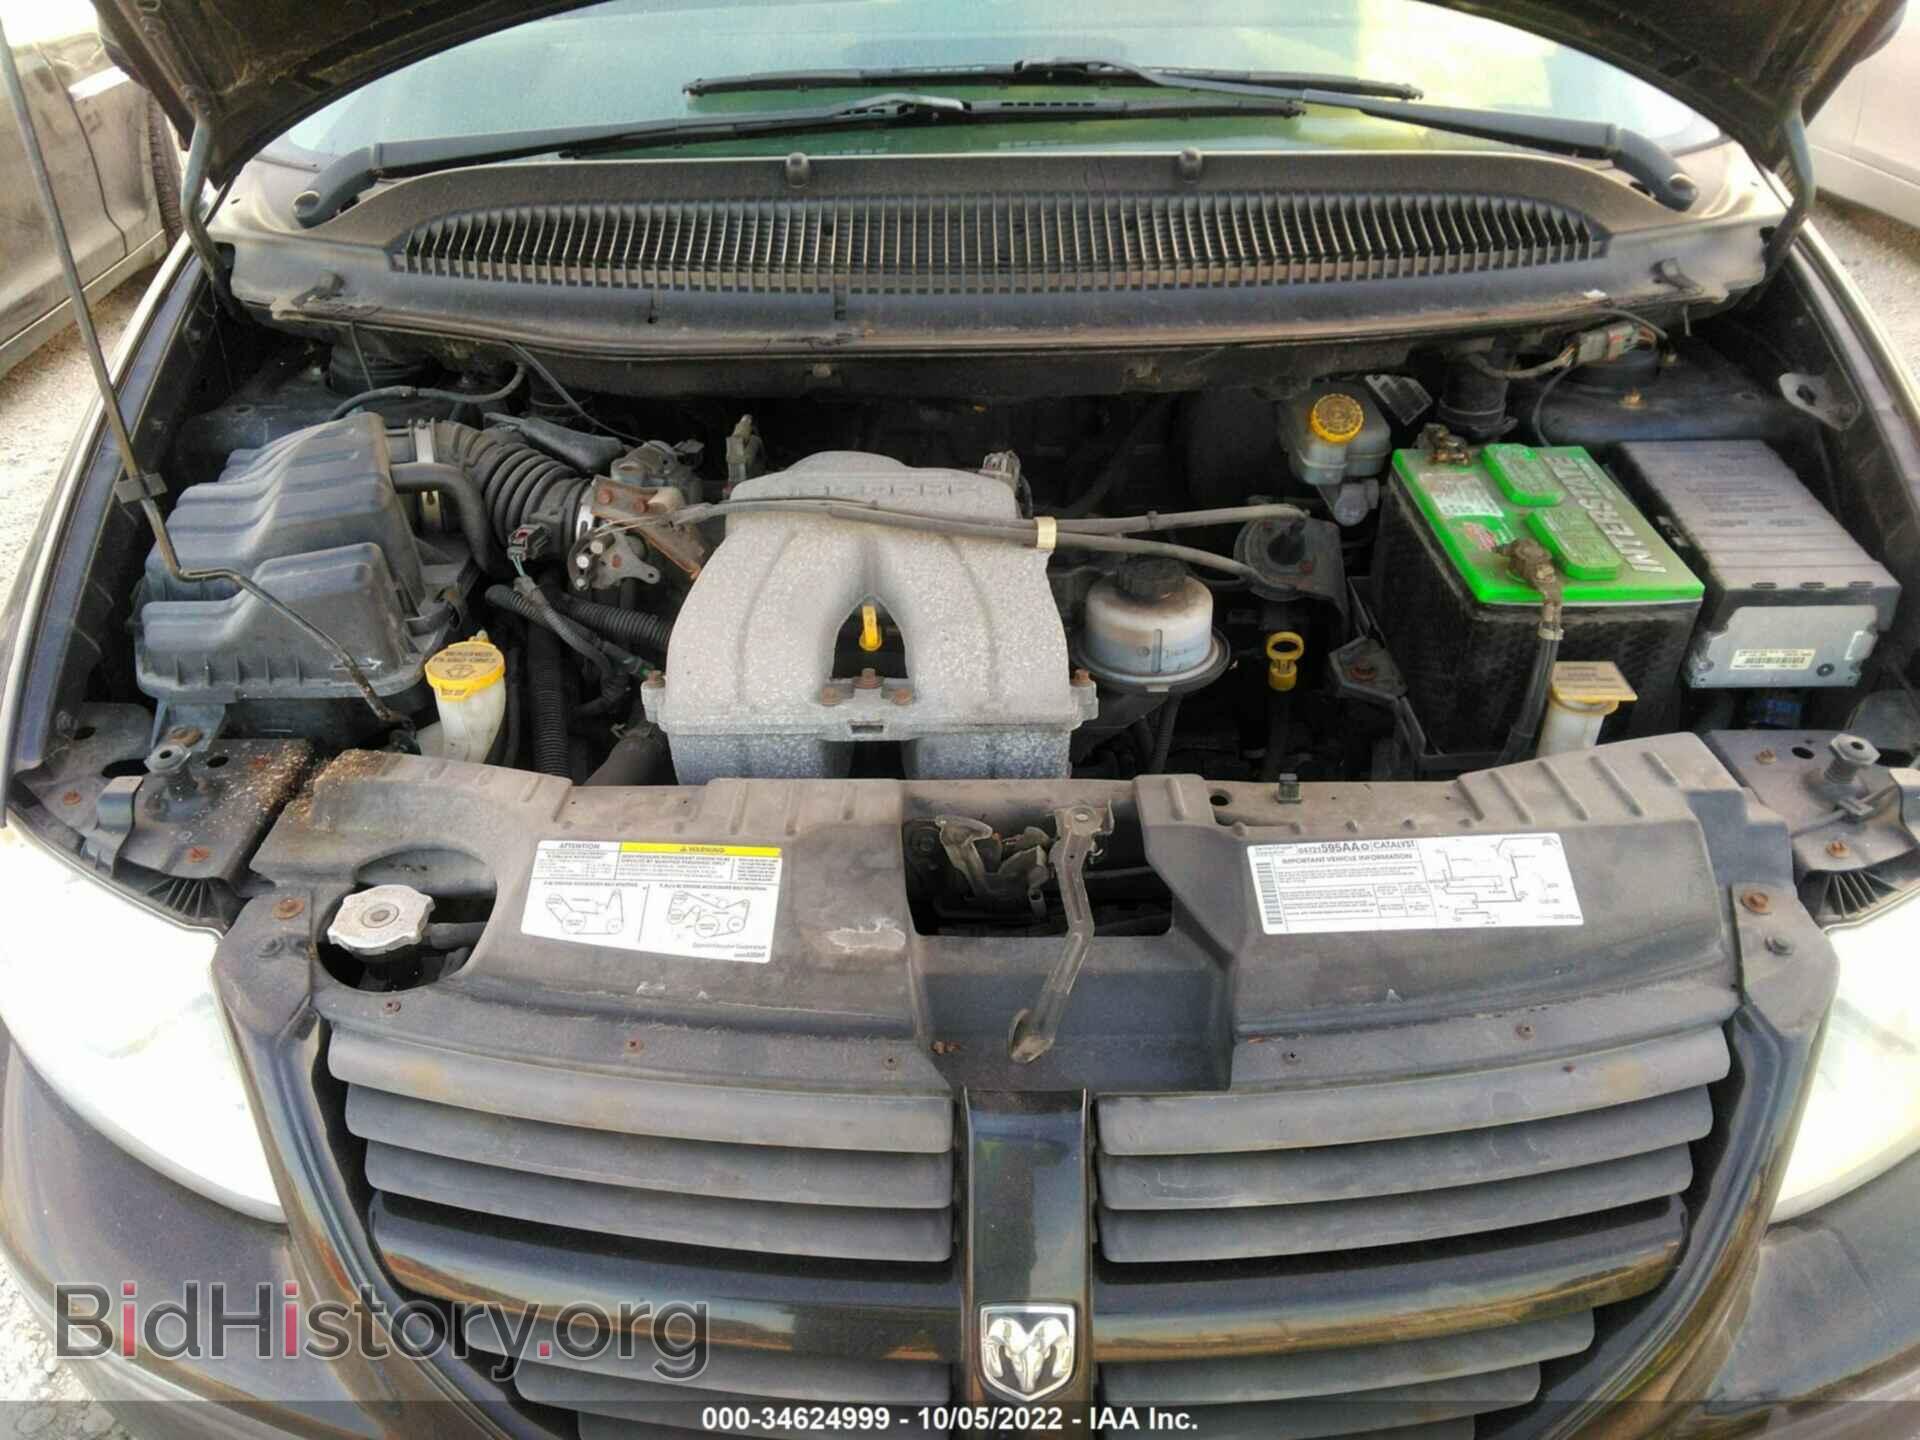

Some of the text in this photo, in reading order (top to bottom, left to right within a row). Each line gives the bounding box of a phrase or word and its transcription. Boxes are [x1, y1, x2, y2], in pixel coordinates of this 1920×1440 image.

[558, 842, 601, 850] ATTENTION
[1373, 839, 1416, 849] CATALYST
[1282, 856, 1325, 864] IMPORTANT
